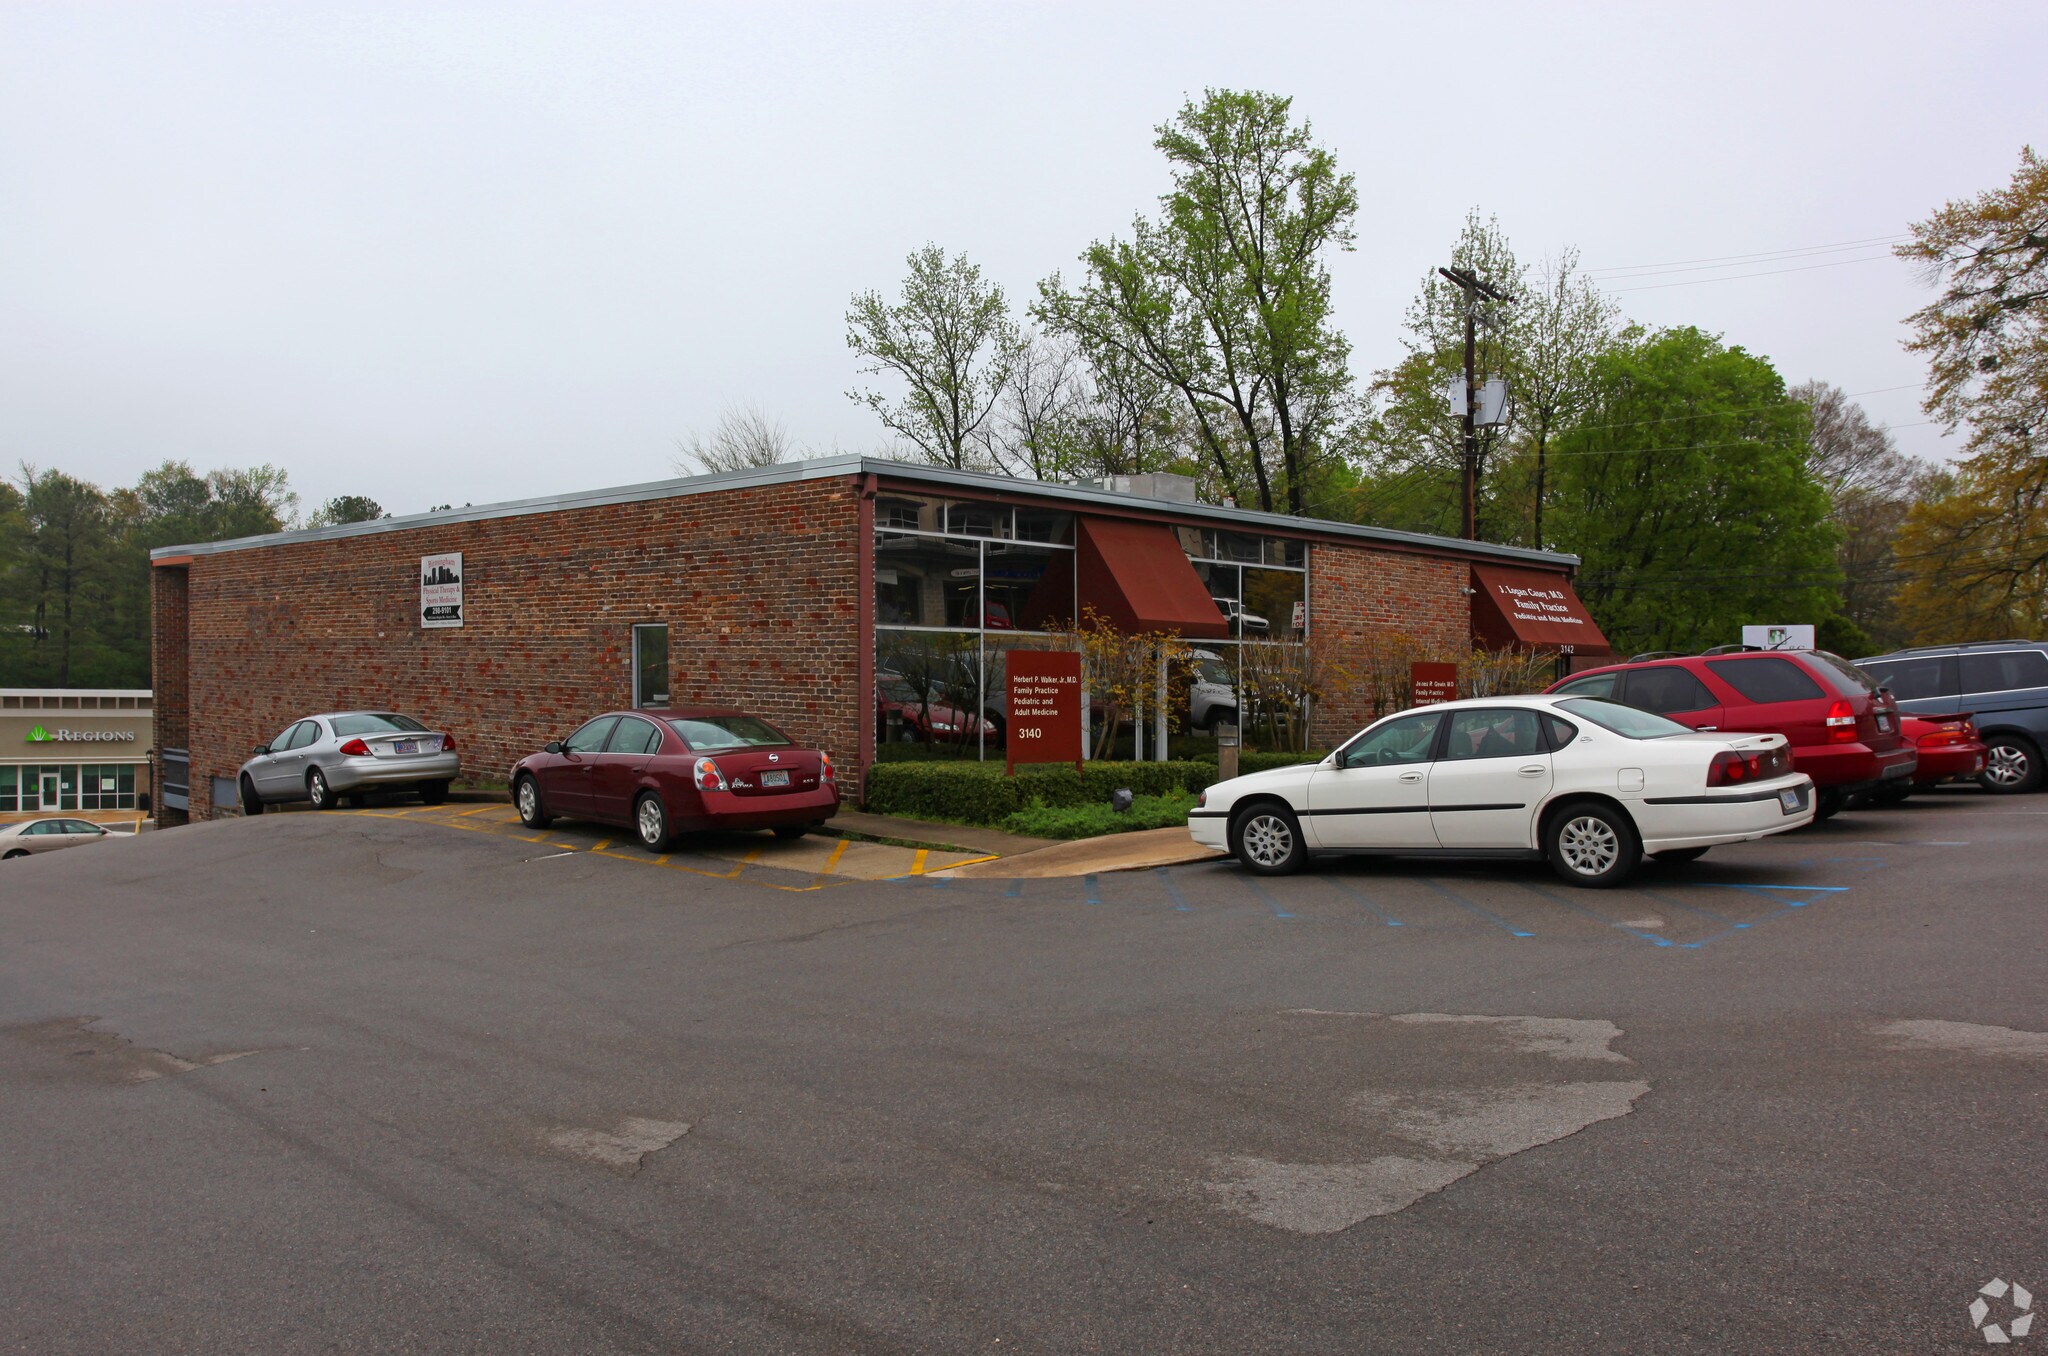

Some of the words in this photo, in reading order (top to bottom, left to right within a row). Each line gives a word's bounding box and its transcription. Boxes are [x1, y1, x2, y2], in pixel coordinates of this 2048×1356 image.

[1514, 599, 1540, 612] Family
[1539, 602, 1568, 612] Practice
[1560, 645, 1574, 654] 3142
[1014, 687, 1033, 695] Family
[1019, 728, 1041, 738] 3140
